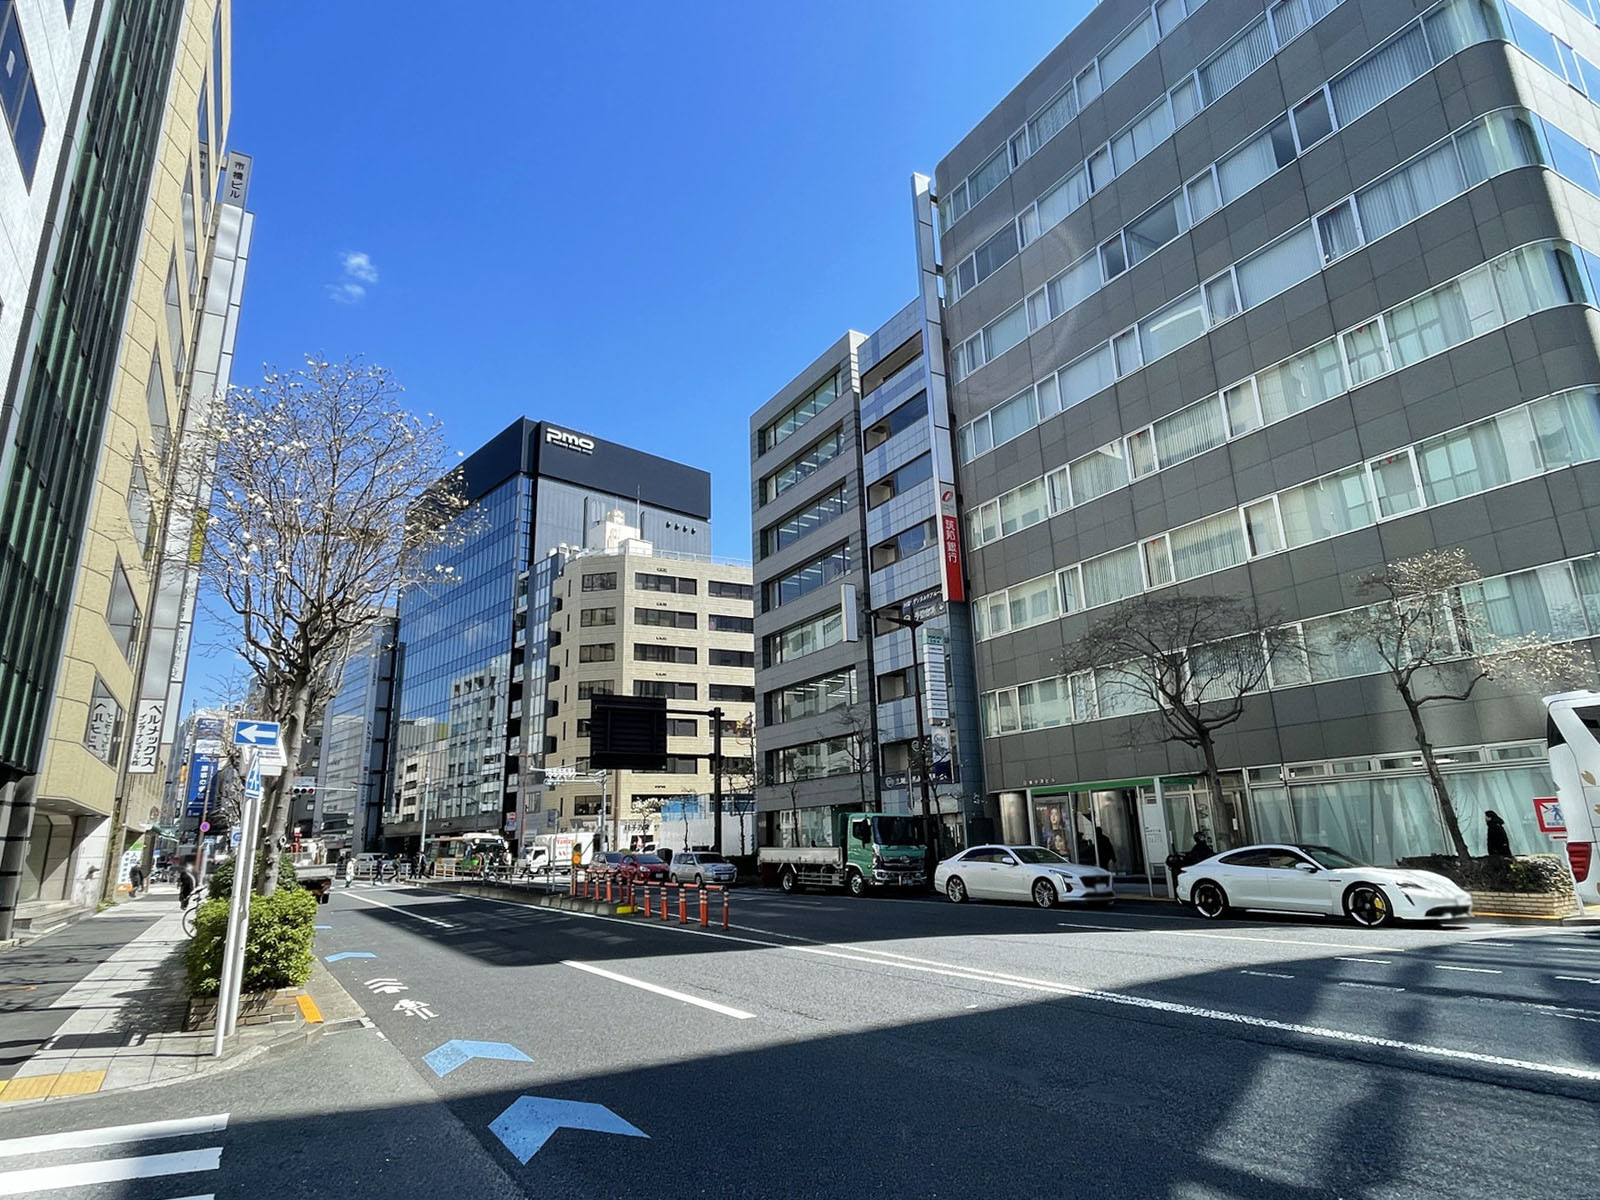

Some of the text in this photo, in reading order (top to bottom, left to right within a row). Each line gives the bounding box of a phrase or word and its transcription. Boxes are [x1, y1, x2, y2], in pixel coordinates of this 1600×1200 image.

[141, 705, 163, 768] ベルメックス
